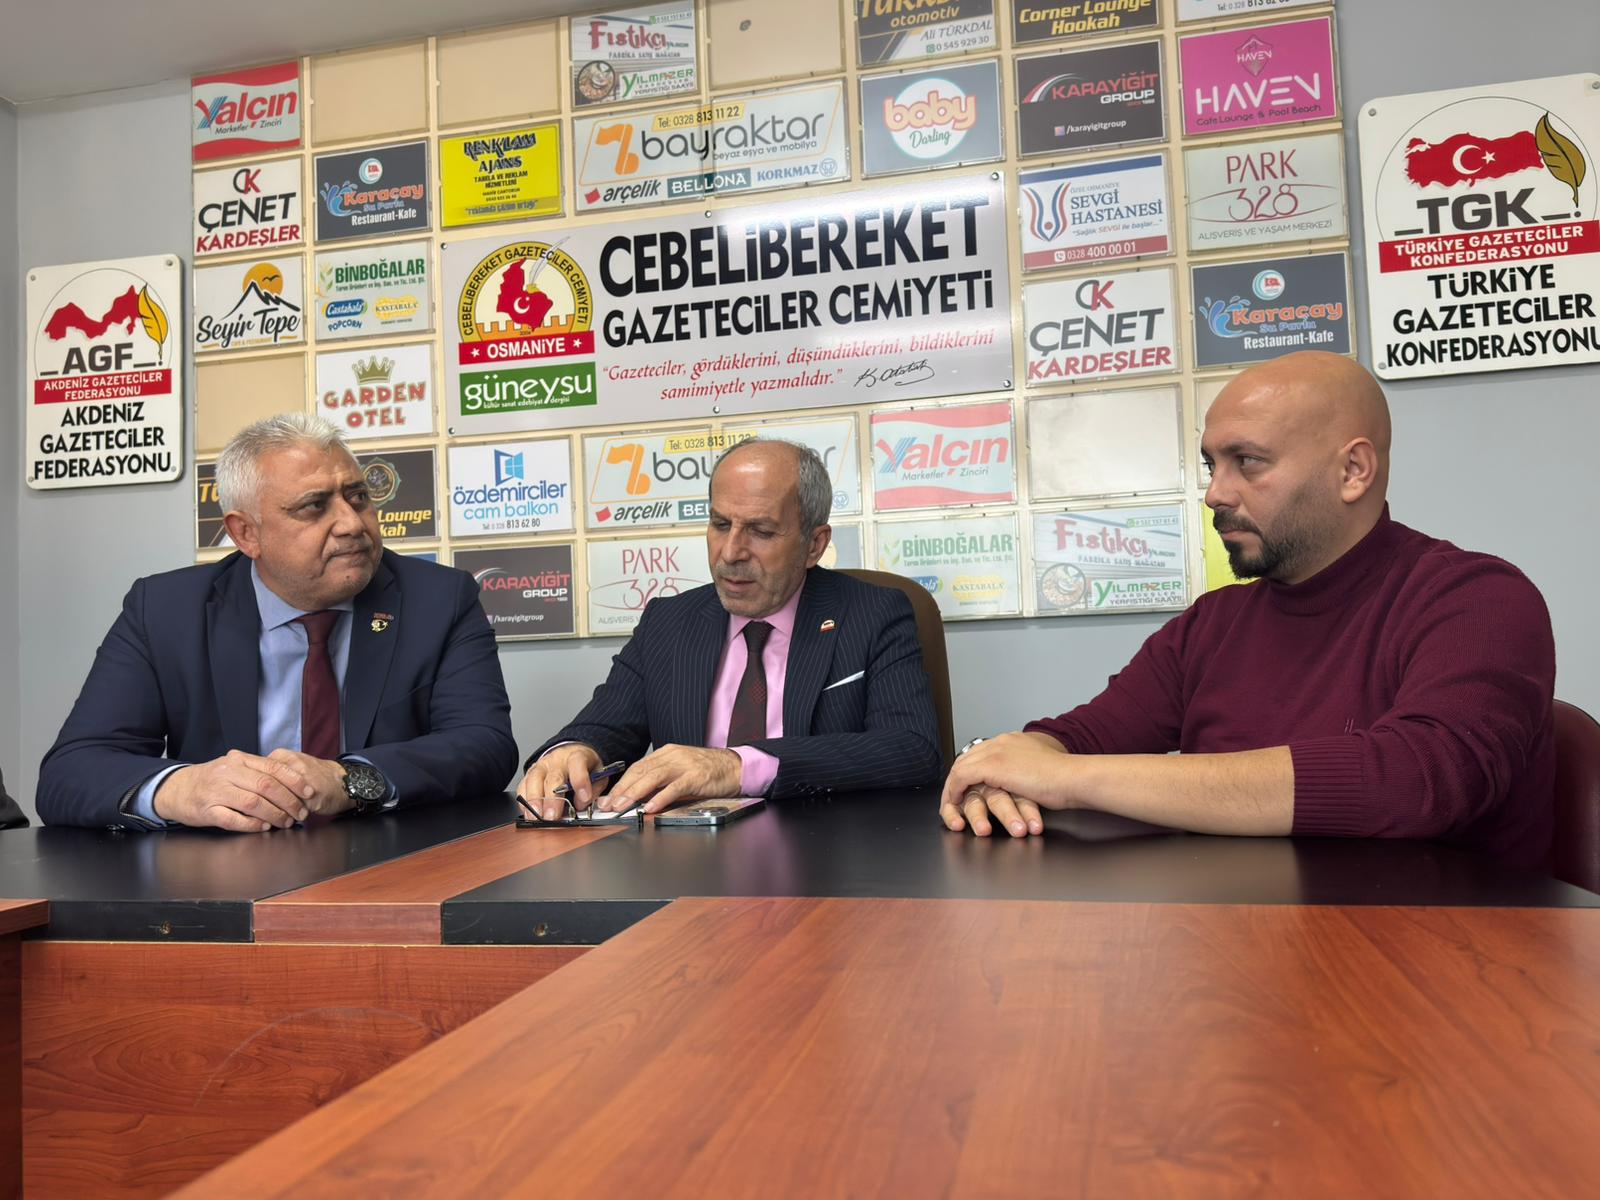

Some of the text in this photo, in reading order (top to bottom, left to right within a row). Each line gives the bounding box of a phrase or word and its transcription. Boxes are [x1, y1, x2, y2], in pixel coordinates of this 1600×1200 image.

[890, 6, 960, 28] otomotiv
[1019, 0, 1151, 23] Corner Lounge
[1051, 12, 1121, 35] Hookah
[920, 20, 993, 41] Ali TÜRKDAL
[943, 41, 959, 50] 545
[960, 37, 977, 47] 929
[979, 35, 990, 44] 30
[1237, 50, 1272, 63] HAVEN
[1052, 70, 1158, 100] KARAYİĞİT
[1100, 89, 1155, 104] GROUP
[1196, 72, 1321, 115] HAVEN
[195, 91, 297, 129] Yalçın
[657, 105, 740, 129] Tel: 0328 813 11 22
[884, 90, 977, 132] baby
[1219, 114, 1254, 125] Lounge
[1269, 107, 1290, 117] Pool
[1292, 104, 1321, 114] Beach
[215, 119, 282, 135] Marketler Zinciri
[641, 113, 824, 161] bayraktar
[909, 128, 951, 149] Darling
[1066, 120, 1127, 134] /karayigitgroup
[713, 140, 818, 161] beyaz eşya ve mobilya
[479, 156, 522, 173] AJANS
[505, 170, 528, 179] REKLAM
[757, 163, 819, 182] KORKMAZ
[1226, 149, 1298, 184] PARK
[603, 179, 661, 204] arçelik
[672, 172, 747, 194] BELLONA
[1070, 189, 1120, 210] SEVGİ
[1228, 183, 1298, 221] 328
[1416, 188, 1539, 234] TGK
[198, 192, 296, 233] ÇENET
[351, 208, 417, 226] Restaurant-Kafe
[1071, 199, 1163, 225] HASTANESİ
[196, 224, 300, 252] KARDEŞLER
[1244, 225, 1257, 235] VE
[1258, 224, 1291, 236] YAŞAM
[1293, 219, 1332, 232] MERKEZİ
[600, 199, 991, 297] CEBELİBEREKET
[1067, 241, 1137, 260] 0328 400 00 01
[1395, 225, 1583, 256] TÜRKİYE GAZETECİLER
[1410, 242, 1569, 267] KONFEDERASYONU
[335, 258, 425, 284] BİNBOĞALAR
[1427, 264, 1556, 299] TÜRKİYE
[603, 269, 993, 347] GAZETECİLER CEMİYETİ
[1393, 293, 1596, 334] GAZETECİLER
[196, 314, 255, 348] Seyir
[253, 307, 301, 342] Tepe
[328, 319, 362, 332] POPCORN
[1029, 307, 1165, 357] ÇENET
[487, 338, 566, 359] OSMANİYE
[1244, 330, 1334, 350] Restaurant-Kafe
[62, 342, 133, 375] AGF
[690, 351, 781, 380] gördüklerini,
[787, 337, 903, 366] düşündüklerini,
[910, 329, 995, 353] bildiklerini
[1028, 346, 1171, 380] KARDEŞLER
[44, 372, 163, 391] AKDENİZ GAZETECİLER
[65, 386, 141, 400] FEDERASYONU
[464, 374, 593, 410] güneysu
[661, 377, 746, 401] samimiyetle
[323, 381, 427, 409] GARDEN
[550, 396, 570, 405] dergisi
[61, 402, 145, 427] AKDENİZ
[346, 406, 406, 428] OTEL
[40, 427, 164, 454] GAZETECİLER
[669, 440, 681, 450] Tel:
[685, 438, 704, 449] 0328
[707, 436, 724, 447] 813
[727, 435, 736, 445] 11
[34, 452, 171, 480] FEDERASYONU
[876, 433, 1009, 476] Yalçın
[902, 466, 989, 481] Marketler Zinciri
[453, 480, 567, 505] özdemirciler
[378, 510, 432, 524] Lounge
[464, 501, 559, 520] cam balkon
[613, 502, 672, 523] arçelik
[380, 523, 406, 537] kah
[507, 519, 519, 528] 813
[521, 519, 529, 528] 62
[531, 518, 541, 527] 80
[903, 532, 1012, 557] BİNBOĞALAR
[622, 546, 680, 575] PARK
[482, 571, 570, 591] KARAYİĞİT
[523, 588, 568, 598] GROUP
[1094, 580, 1182, 606] YILMAZER
